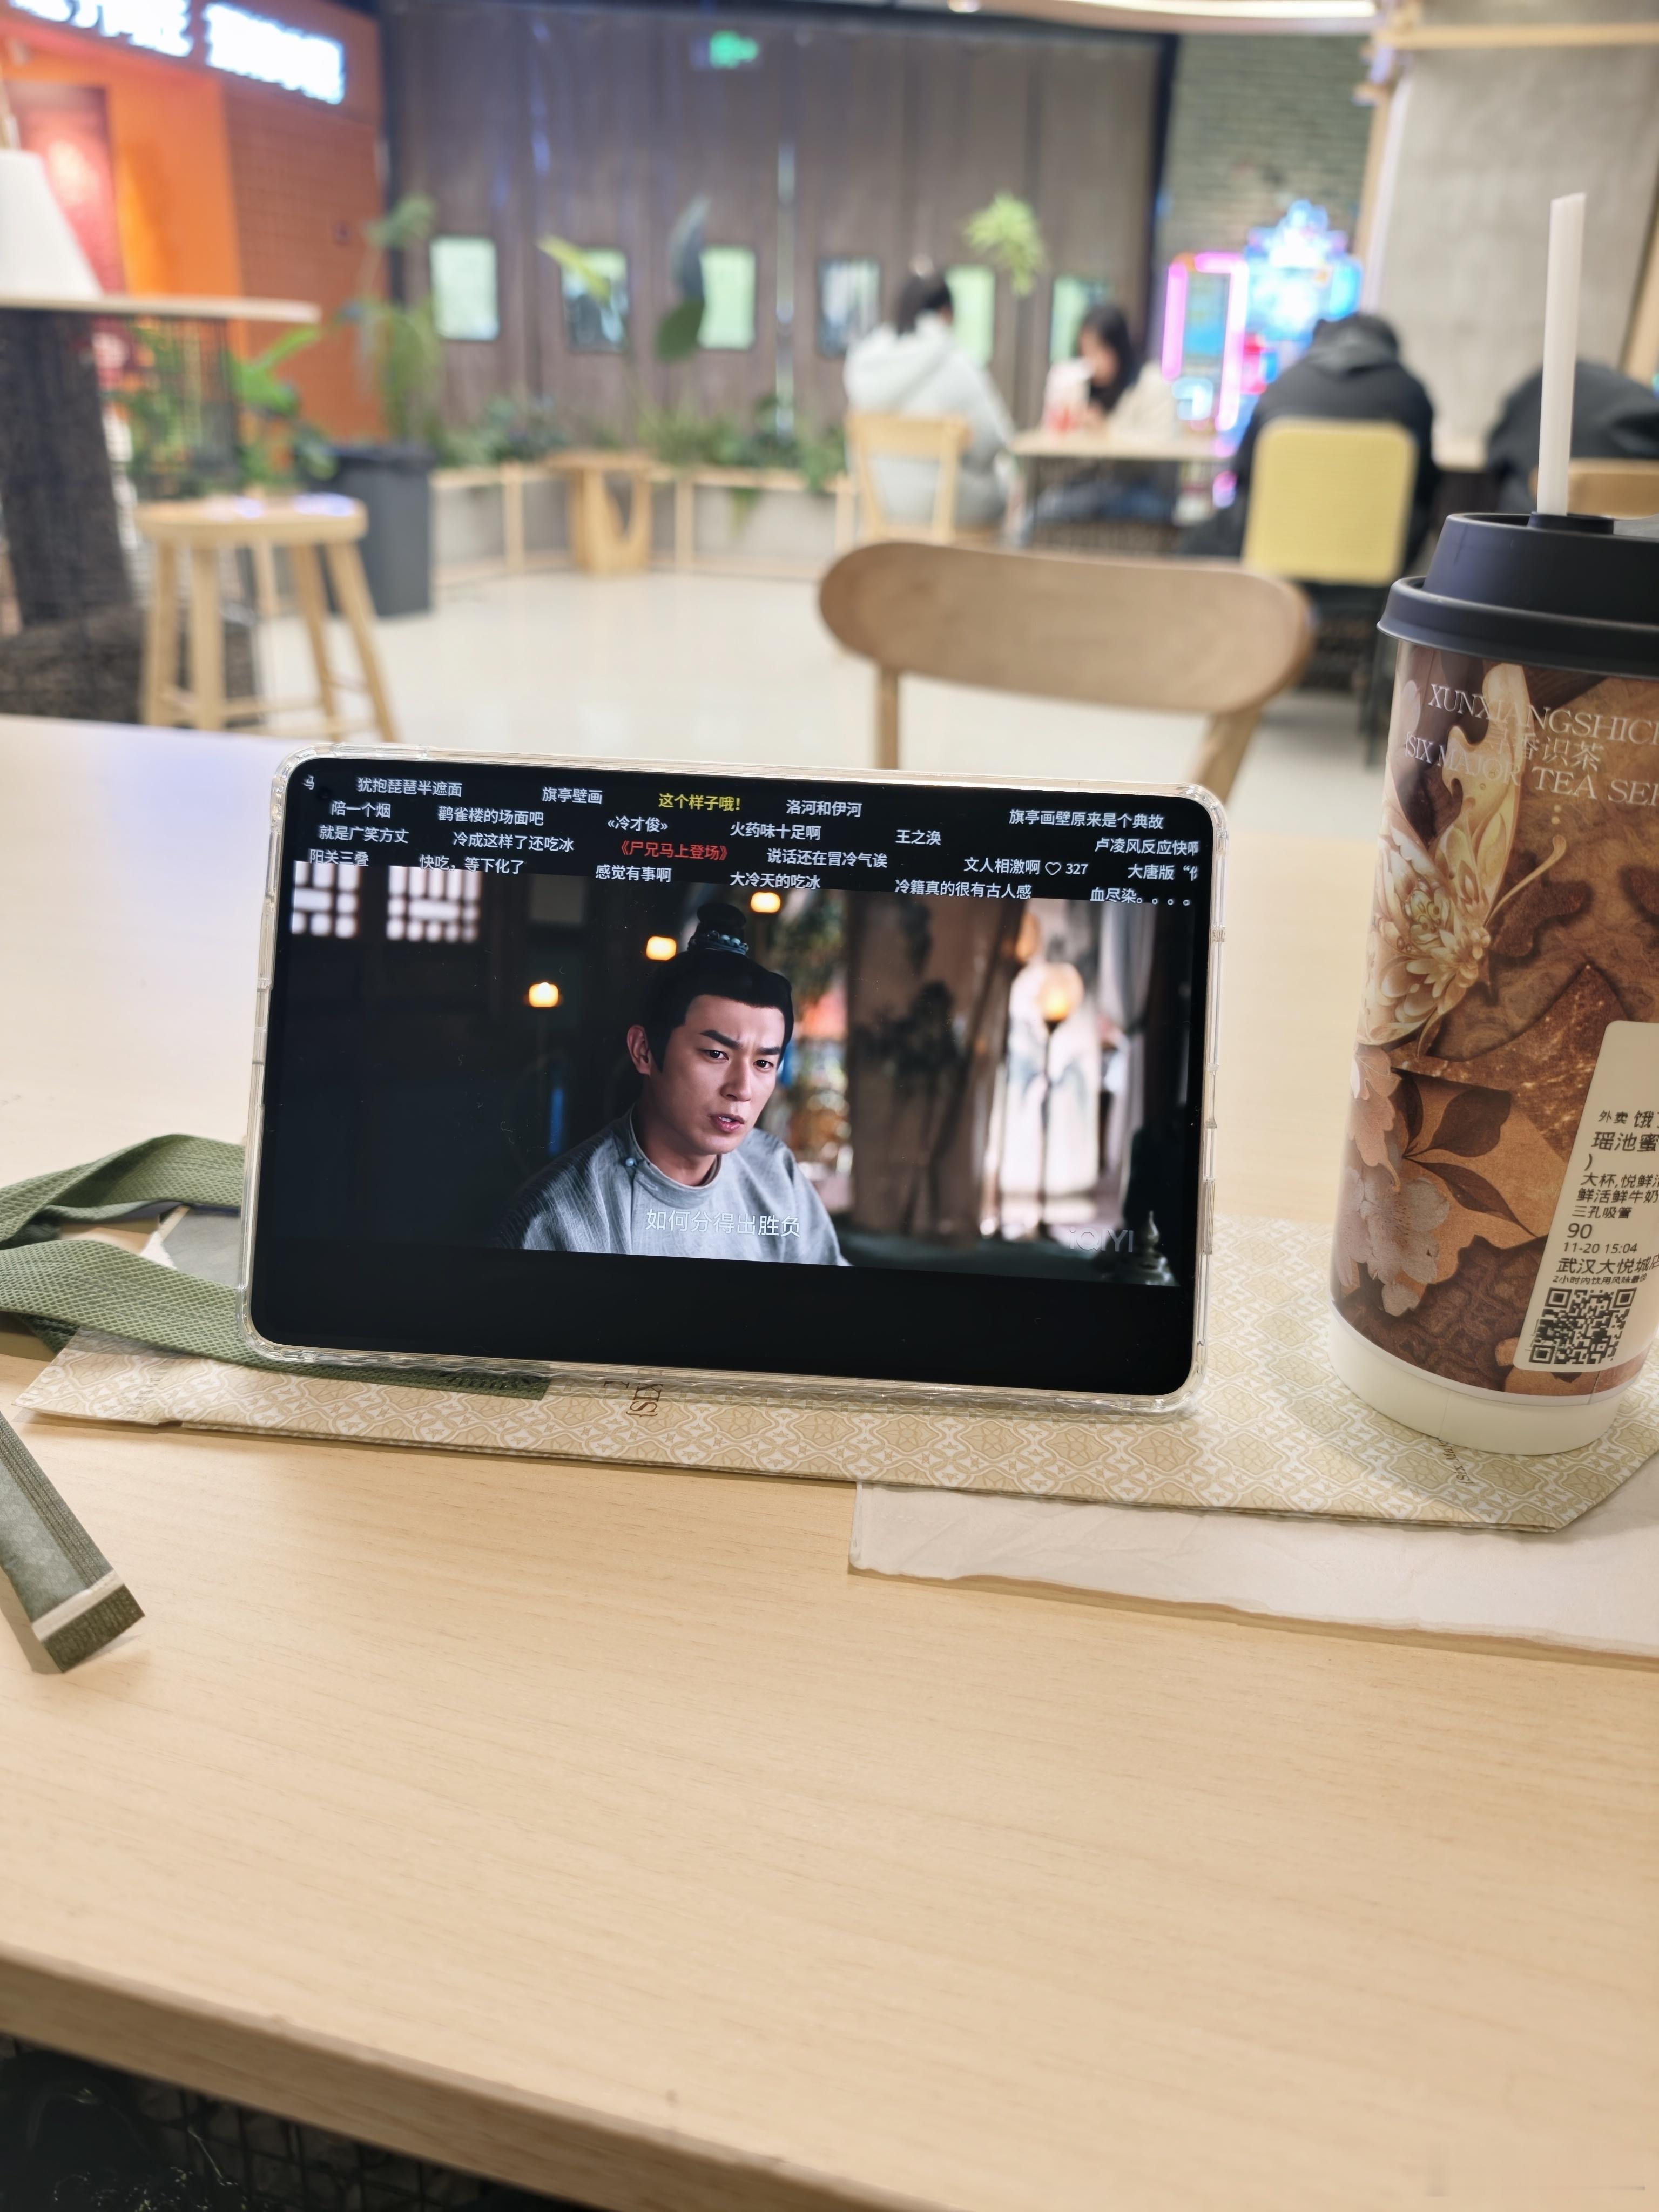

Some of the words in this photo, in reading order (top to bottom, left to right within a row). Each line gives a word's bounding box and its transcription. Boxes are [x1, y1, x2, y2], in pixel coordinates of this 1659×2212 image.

[356, 777, 462, 798] 犹抱琵琶半遮面
[1532, 766, 1597, 800] TEA
[542, 786, 603, 805] 旗亭壁画
[329, 800, 391, 819] 陪一个烟
[438, 805, 544, 826] 鹳雀楼的场面吧
[786, 799, 862, 818] 洛河和伊河
[1009, 809, 1164, 830] 旗亭画壁原来是个典故
[319, 825, 409, 844] 就是广笑方丈
[730, 822, 821, 841] 火药味十足啊
[895, 830, 942, 846] 王之涣
[452, 831, 575, 853] 冷成这样了还吃冰
[621, 840, 728, 860] 《尸兄马上登场》
[1094, 837, 1199, 857] 卢凌风反应快啊
[309, 848, 369, 867] 阳关三叠
[767, 848, 888, 868] 说话还在冒冷气诶
[964, 857, 1041, 875] 文人相激啊
[1065, 864, 1088, 876] 327
[595, 864, 672, 883] 感觉有事啊
[730, 871, 821, 890] 大冷天的吃冰
[894, 878, 1032, 900] 冷籍真的很有古人感
[1597, 1110, 1628, 1124] 外卖
[1634, 1110, 1659, 1129] 饿
[1591, 1131, 1659, 1152] 瑶池蜜
[1576, 1188, 1659, 1204] 鲜活鲜牛奶
[1572, 1205, 1633, 1219] 三孔吸管
[645, 1209, 800, 1238] 如何分得出胜负
[1567, 1223, 1593, 1239] 90
[1069, 1226, 1134, 1253] iQIYI
[1563, 1242, 1600, 1254] 11-20
[1604, 1243, 1637, 1254] 15:04
